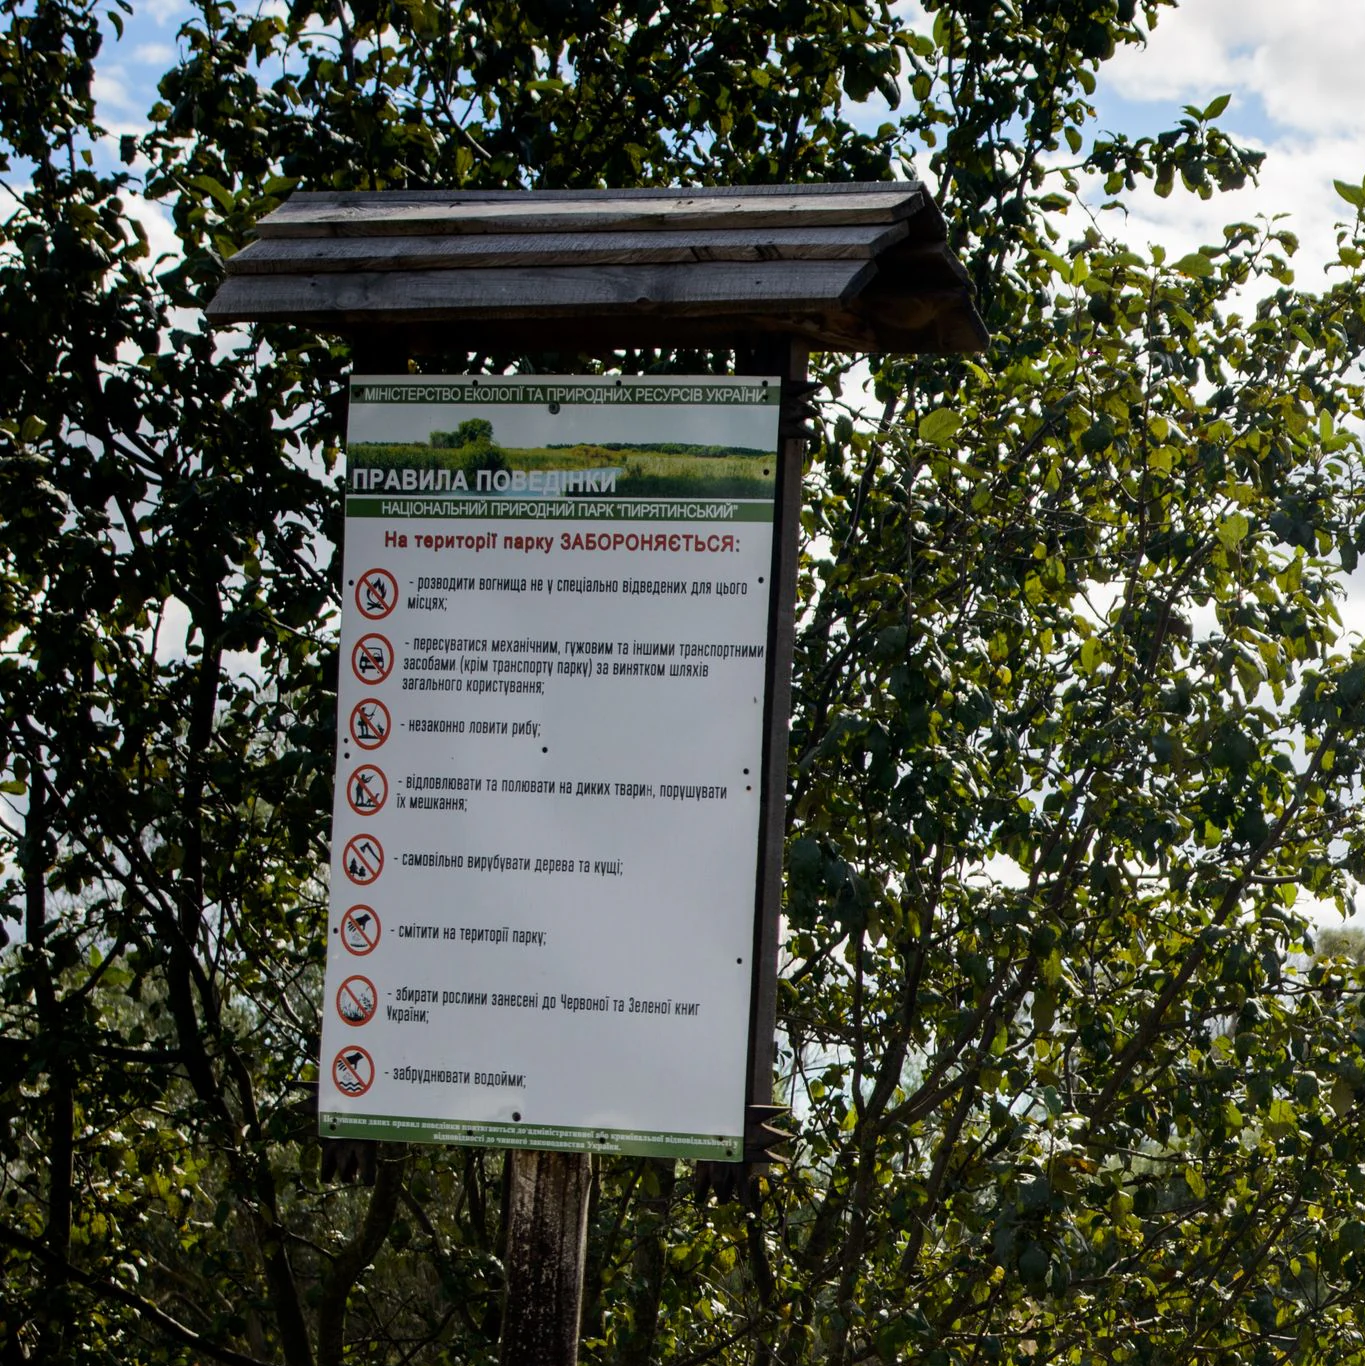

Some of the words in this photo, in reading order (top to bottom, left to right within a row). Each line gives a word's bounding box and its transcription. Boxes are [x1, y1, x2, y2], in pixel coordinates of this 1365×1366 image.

[364, 387, 461, 401] МІНІСТЕРСТВО
[464, 387, 523, 401] ЕКОЛОГІЇ
[526, 388, 544, 401] ТА
[547, 388, 632, 404] ПРИРОДНИХ
[635, 388, 702, 402] РЕСУРСІВ
[706, 387, 767, 403] УКРАЇНИ
[353, 468, 469, 491] ПРАВИЛА
[477, 470, 616, 496] ПОВЕДІНКИ
[381, 500, 487, 518] НАЦІОНАЛЬНИЙ
[491, 501, 575, 518] ПРИРОДНИЙ
[578, 503, 614, 517] ПАРК
[384, 530, 408, 548] На
[414, 532, 498, 552] території
[503, 536, 554, 554] парку
[560, 532, 741, 552] ЗАБОРОНЯЄТЬСЯ:
[417, 576, 475, 592] розводити
[479, 578, 527, 593] вогнища
[530, 578, 543, 592] не
[547, 579, 553, 594] у
[557, 577, 618, 594] спеціально
[622, 577, 687, 595] відведених
[690, 581, 712, 596] для
[716, 582, 748, 597] цього
[407, 594, 448, 612] місцях;
[413, 637, 487, 654] пересуватися
[491, 637, 561, 655] механічним,
[565, 640, 613, 657] гужовим
[617, 642, 629, 655] та
[632, 640, 675, 656] іншими
[679, 643, 764, 660] транспортними
[403, 655, 456, 672] засобами
[460, 655, 488, 675] (крім
[492, 660, 553, 677] транспорту
[557, 658, 592, 678] парку)
[596, 662, 609, 675] за
[612, 663, 666, 677] винятком
[669, 661, 709, 677] шляхів
[402, 677, 462, 692] загального
[466, 678, 545, 695] користування;
[409, 719, 465, 733] незаконно
[468, 721, 508, 734] ловити
[512, 720, 541, 738] рибу;
[406, 774, 482, 791] відловлювати
[486, 778, 497, 792] та
[501, 778, 556, 794] полювати
[559, 781, 572, 795] на
[575, 781, 611, 796] диких
[614, 783, 656, 799] тварин,
[659, 784, 728, 801] порушувати
[396, 792, 406, 809] їх
[409, 796, 468, 812] мешкання;
[402, 851, 464, 868] самовільно
[467, 854, 531, 872] вирубувати
[534, 859, 575, 875] дерева
[579, 860, 590, 873] та
[594, 858, 624, 877] кущі;
[398, 922, 439, 939] смітити
[443, 926, 456, 940] на
[460, 926, 510, 944] території
[512, 930, 547, 947] парку;
[395, 986, 439, 1004] збирати
[442, 989, 488, 1006] рослини
[491, 992, 539, 1008] занесені
[541, 995, 557, 1010] до
[560, 994, 610, 1013] Червоної
[613, 999, 625, 1012] та
[628, 996, 672, 1015] Зеленої
[674, 1002, 700, 1016] книг
[386, 1005, 430, 1024] України;
[393, 1066, 470, 1084] забруднювати
[474, 1071, 527, 1089] водойми;
